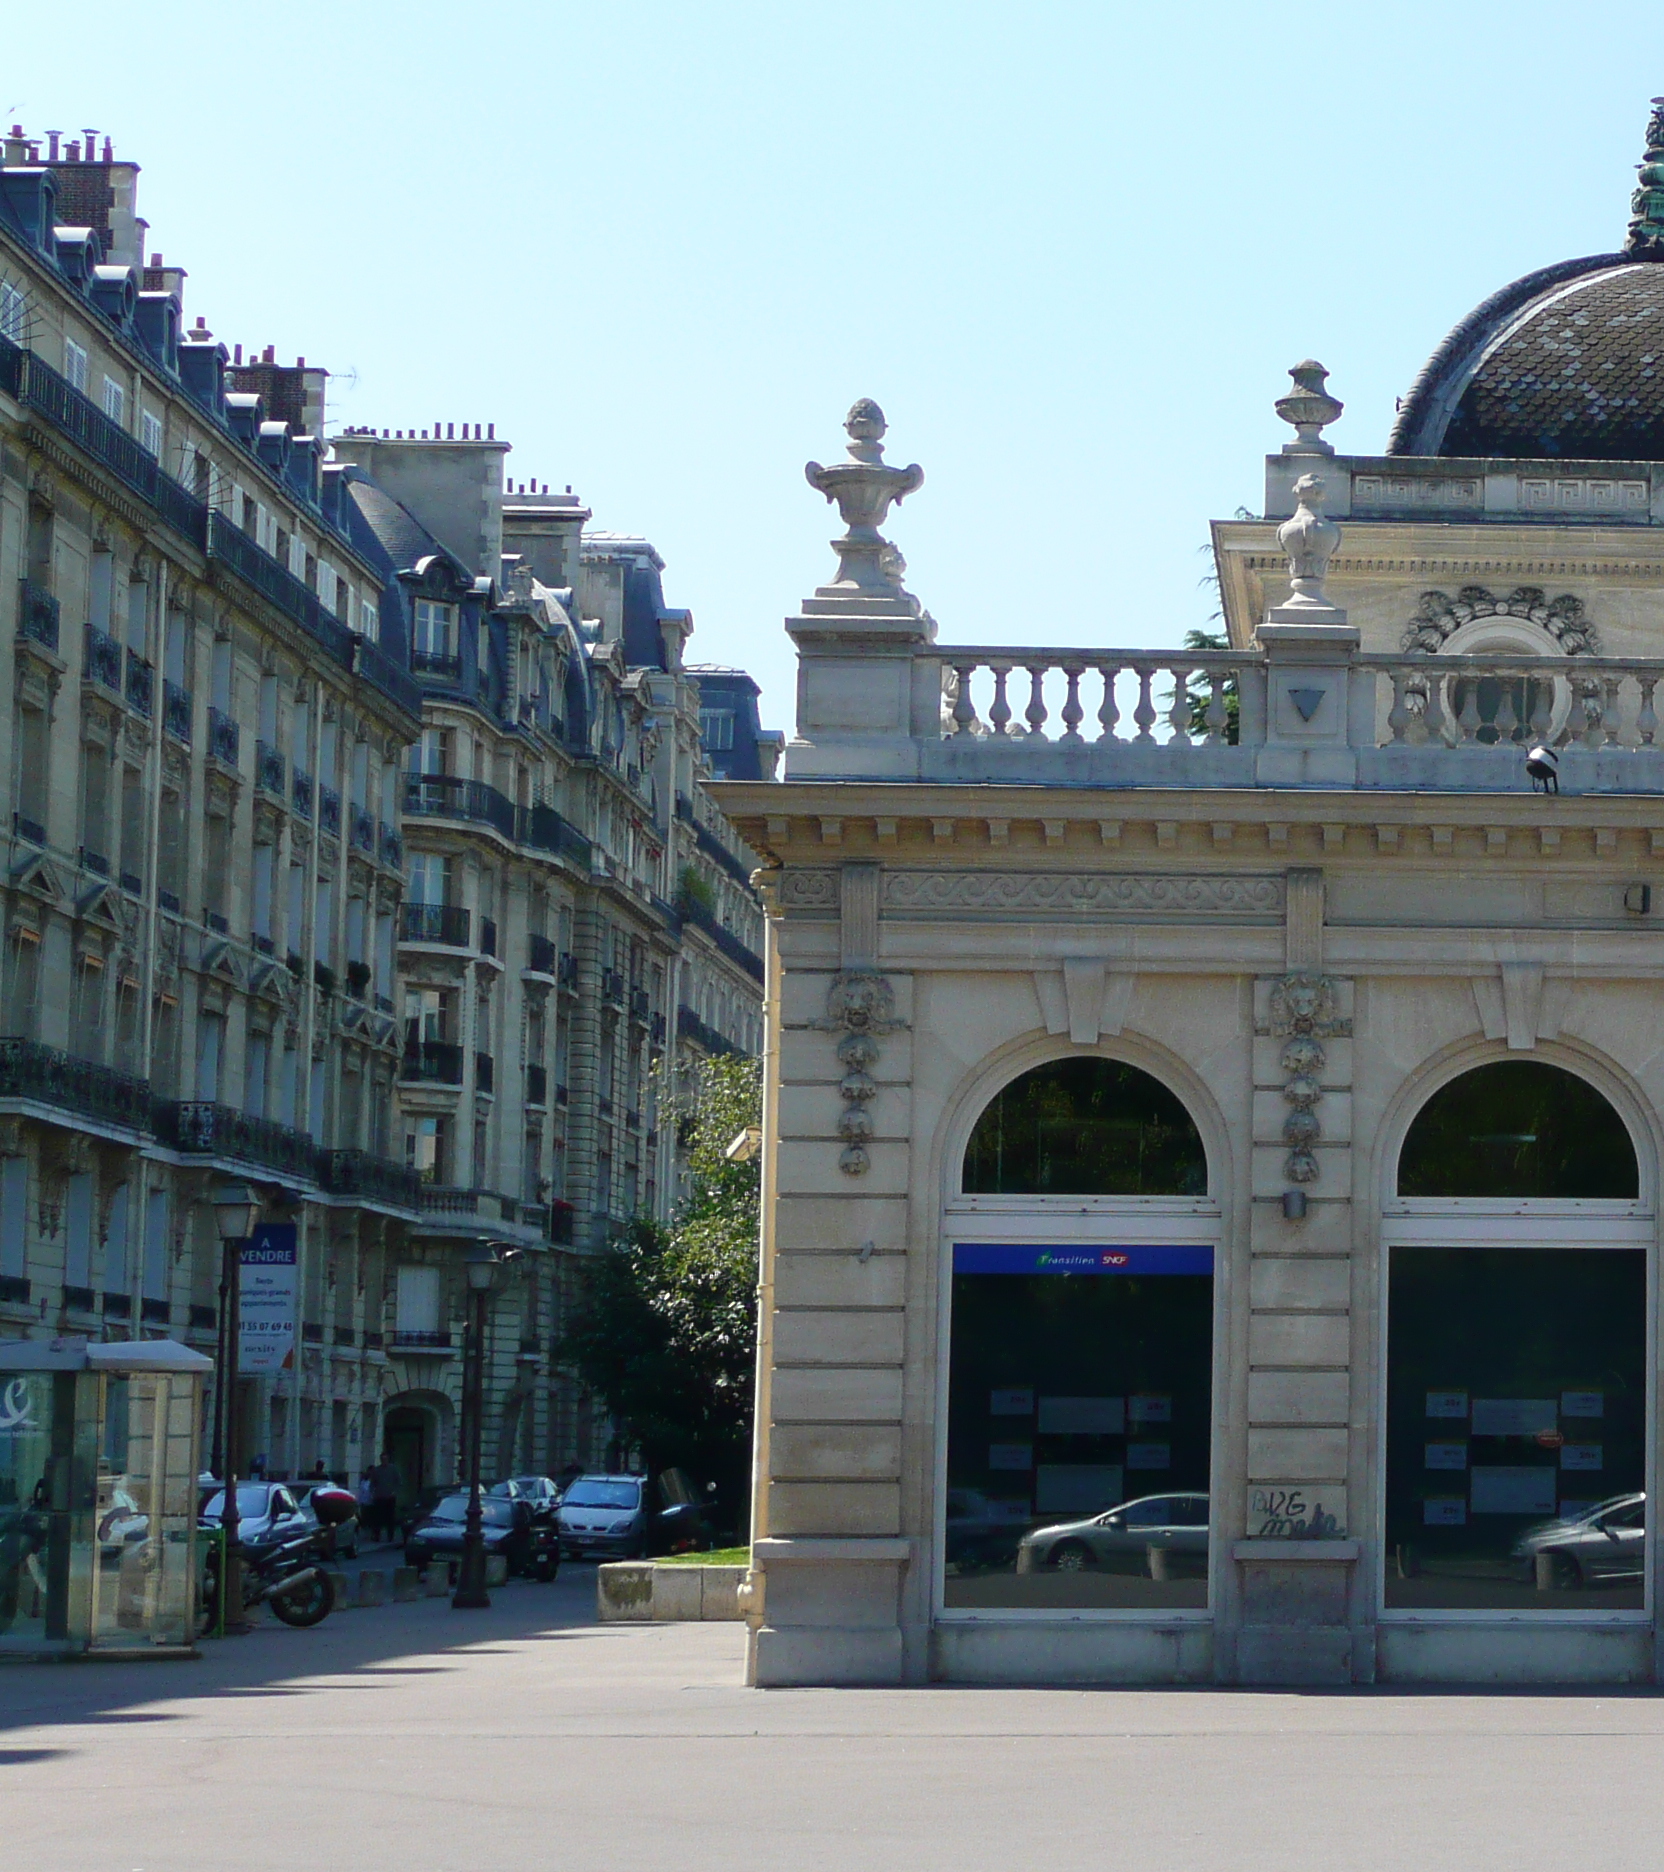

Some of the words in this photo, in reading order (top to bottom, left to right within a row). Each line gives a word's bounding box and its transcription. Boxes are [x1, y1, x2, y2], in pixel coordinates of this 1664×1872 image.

[261, 1237, 270, 1247] A
[240, 1250, 292, 1262] VENDRE
[1102, 1255, 1128, 1265] SNCF
